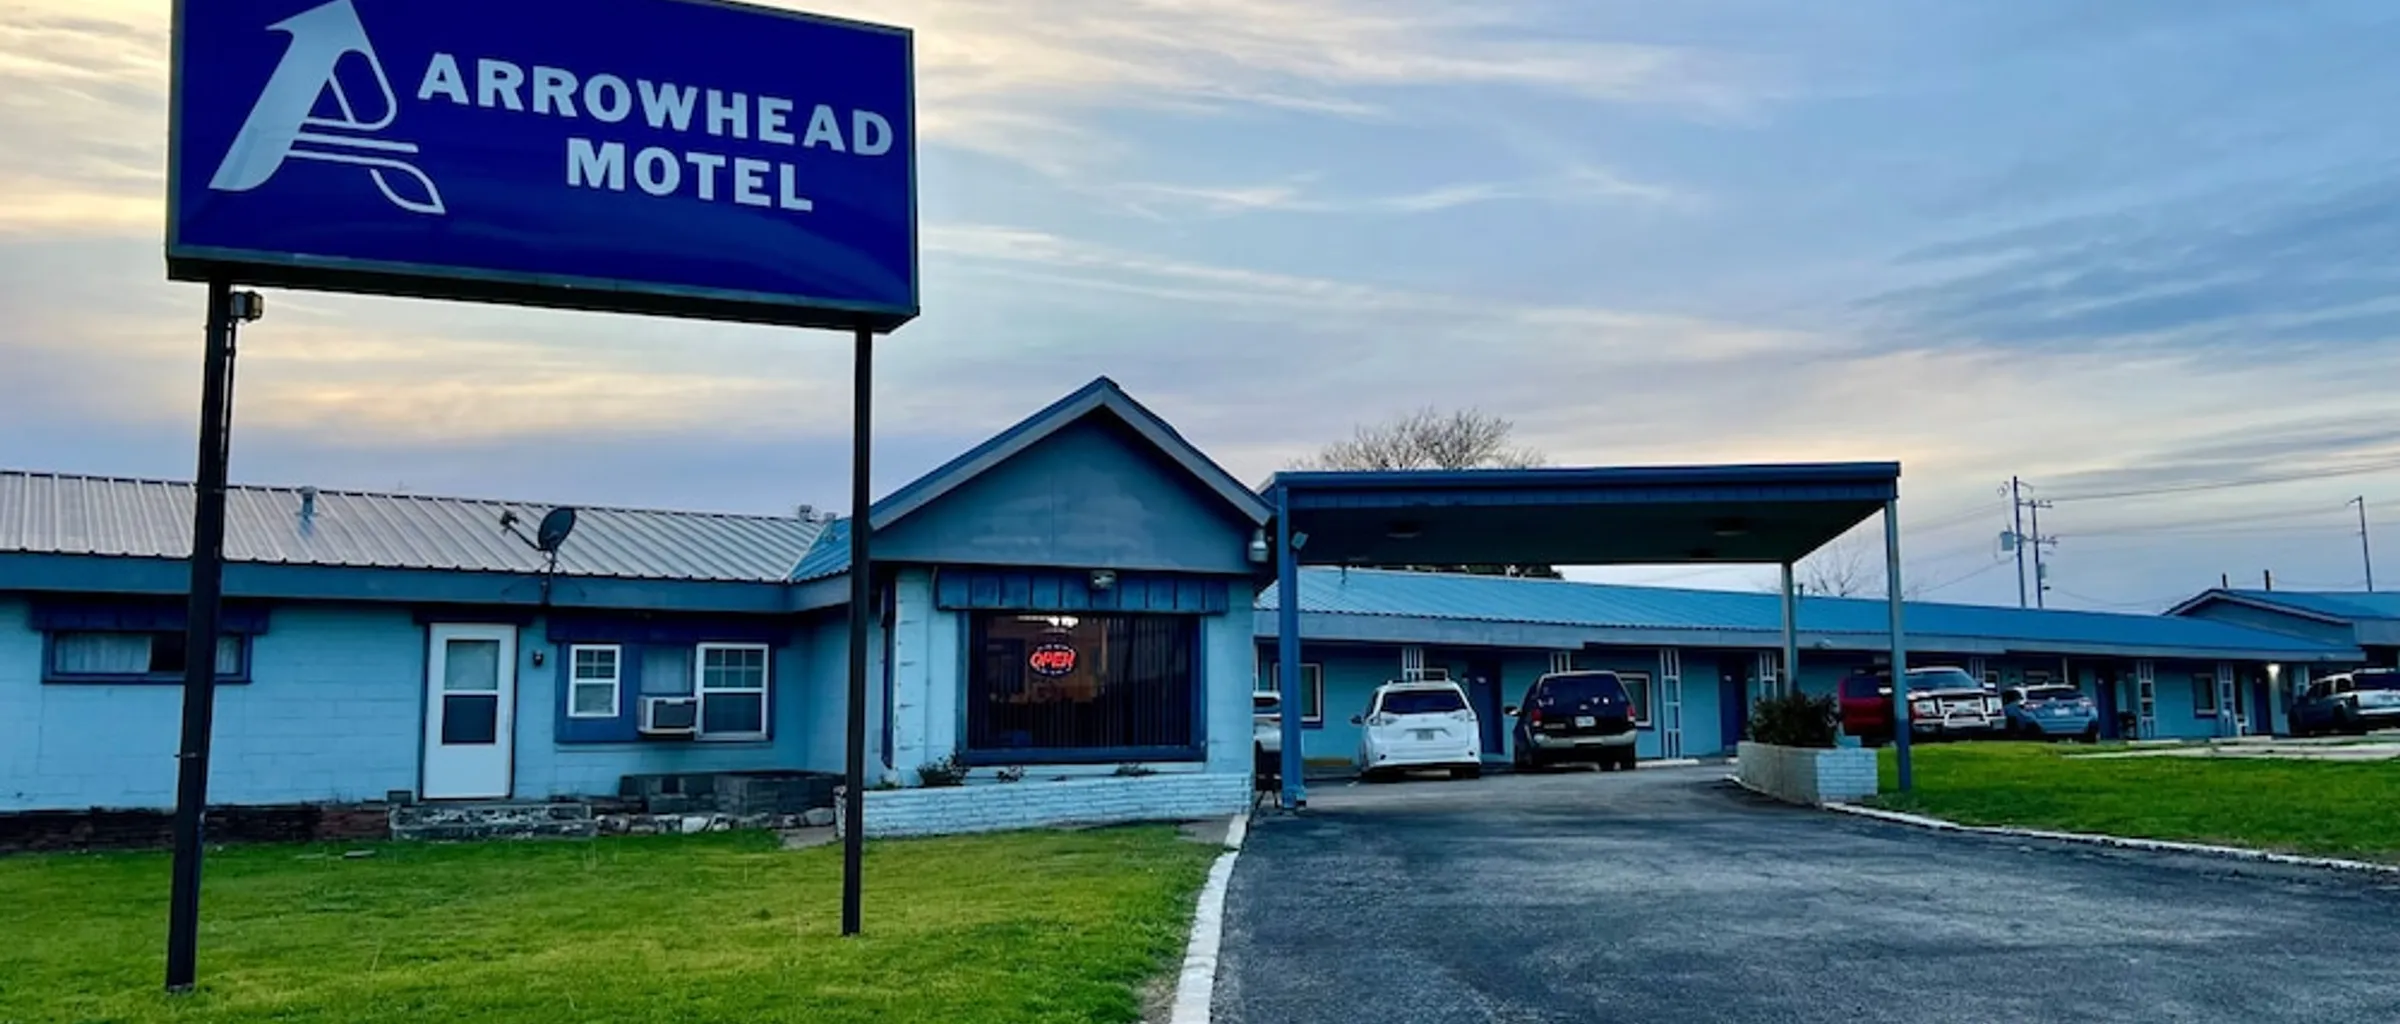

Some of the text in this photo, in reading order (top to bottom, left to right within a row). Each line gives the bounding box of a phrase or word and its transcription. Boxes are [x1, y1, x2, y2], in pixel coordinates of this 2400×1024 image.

[418, 53, 892, 155] ARROWHEAD
[568, 138, 812, 211] MOTEL
[1030, 651, 1075, 668] OPEN
